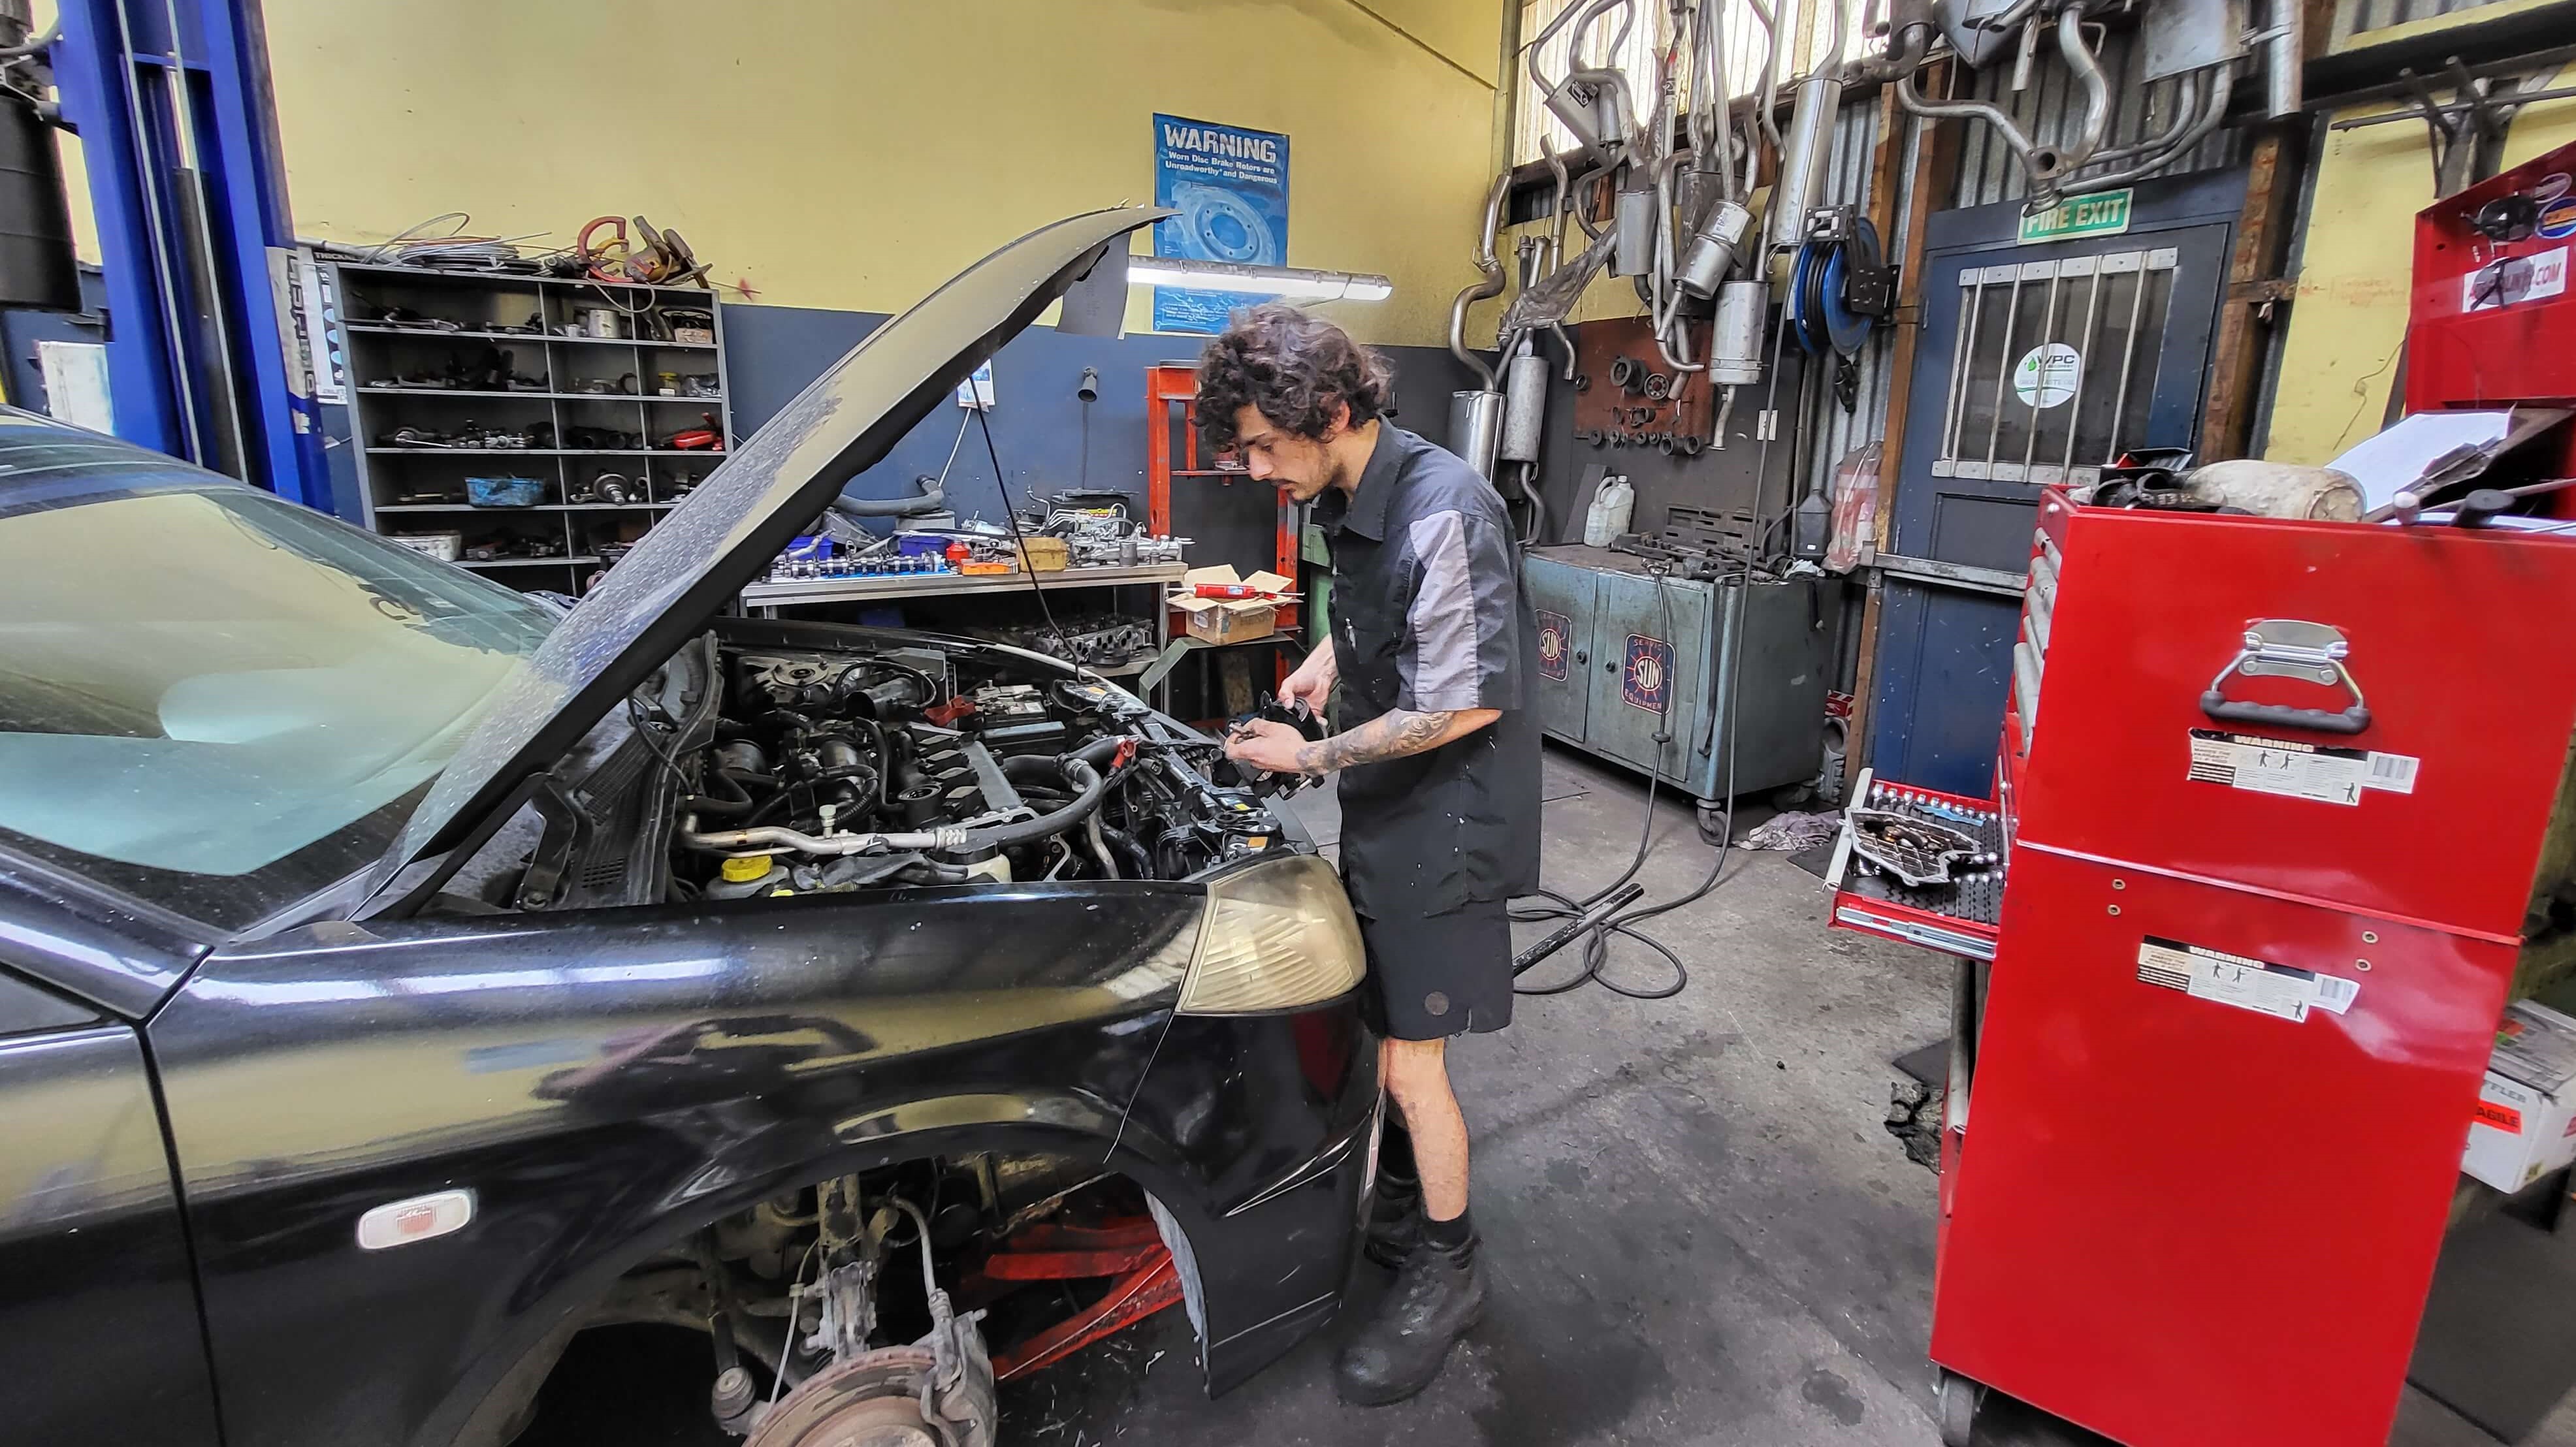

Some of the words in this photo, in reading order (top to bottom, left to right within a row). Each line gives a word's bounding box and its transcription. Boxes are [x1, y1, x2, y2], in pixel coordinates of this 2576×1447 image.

[1164, 124, 1276, 163] WARNING
[1168, 151, 1189, 161] Worn
[1192, 154, 1208, 164] Disc
[1212, 157, 1234, 168] Brake
[1236, 161, 1261, 172] Rotors
[1223, 169, 1237, 178] and
[1238, 172, 1278, 184] Dangerous
[2027, 205, 2070, 234] FIRE
[2074, 198, 2124, 226] EXIT
[2037, 355, 2075, 364] WPC
[1542, 631, 1558, 658] SUN
[1634, 639, 1663, 651] SERVIC
[1637, 658, 1660, 689] SUN
[1624, 688, 1662, 710] EQUIPMEN
[2234, 735, 2314, 752] WARNING
[2189, 946, 2265, 969] WARNING
[2477, 1106, 2519, 1128] AGILE
